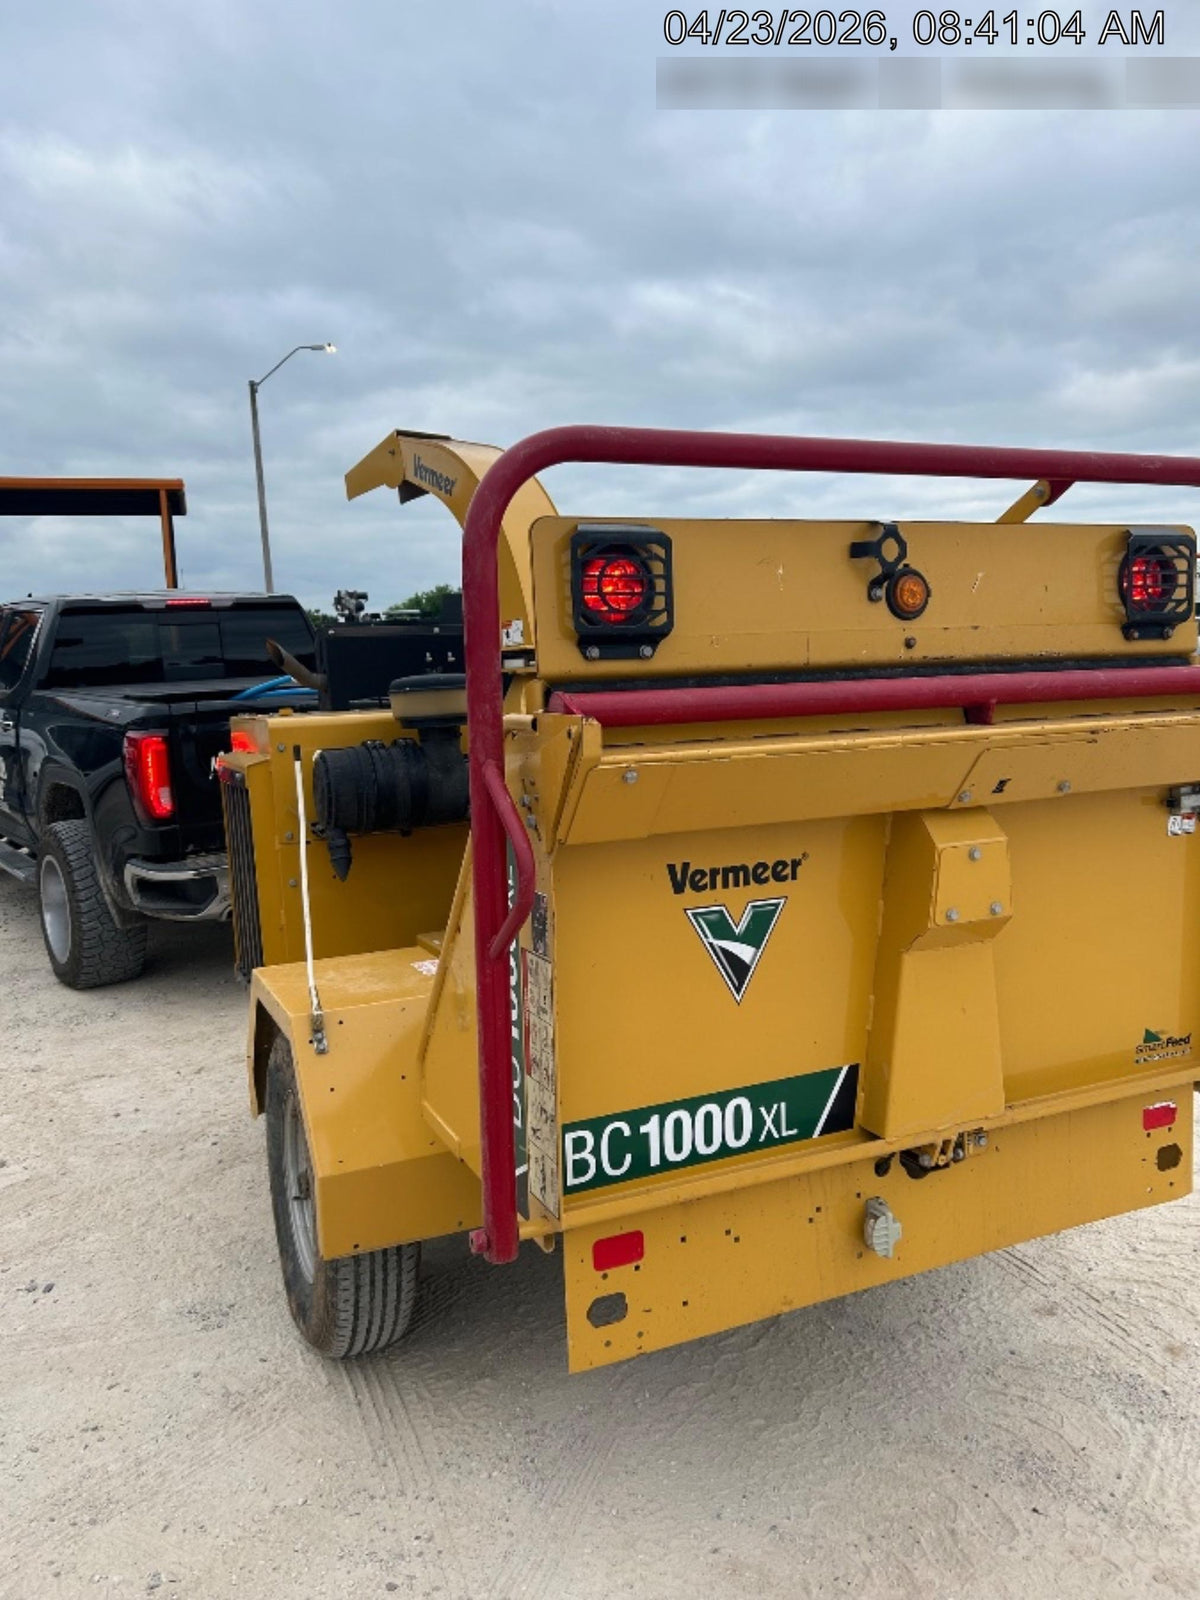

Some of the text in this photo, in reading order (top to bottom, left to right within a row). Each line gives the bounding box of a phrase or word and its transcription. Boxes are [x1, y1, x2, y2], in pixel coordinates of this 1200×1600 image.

[413, 453, 456, 496] Vermeer
[564, 1121, 632, 1187] BC
[639, 1096, 753, 1168] 1000
[758, 1102, 799, 1143] XL
